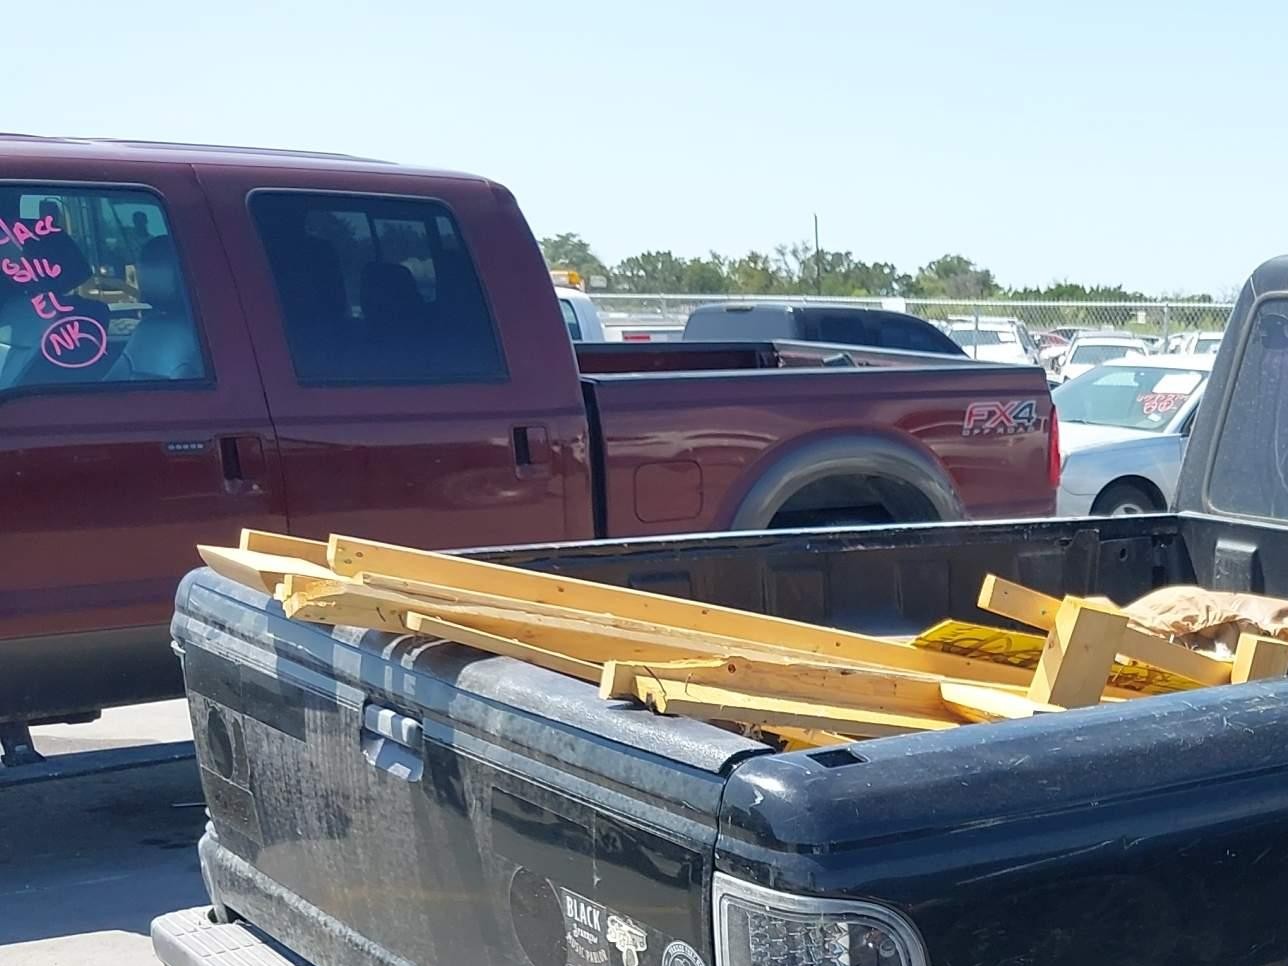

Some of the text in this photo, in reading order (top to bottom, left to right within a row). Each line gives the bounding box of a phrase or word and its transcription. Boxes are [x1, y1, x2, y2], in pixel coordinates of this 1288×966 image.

[31, 292, 74, 319] EL
[964, 400, 1036, 429] FX4
[565, 895, 600, 932] BLACK
